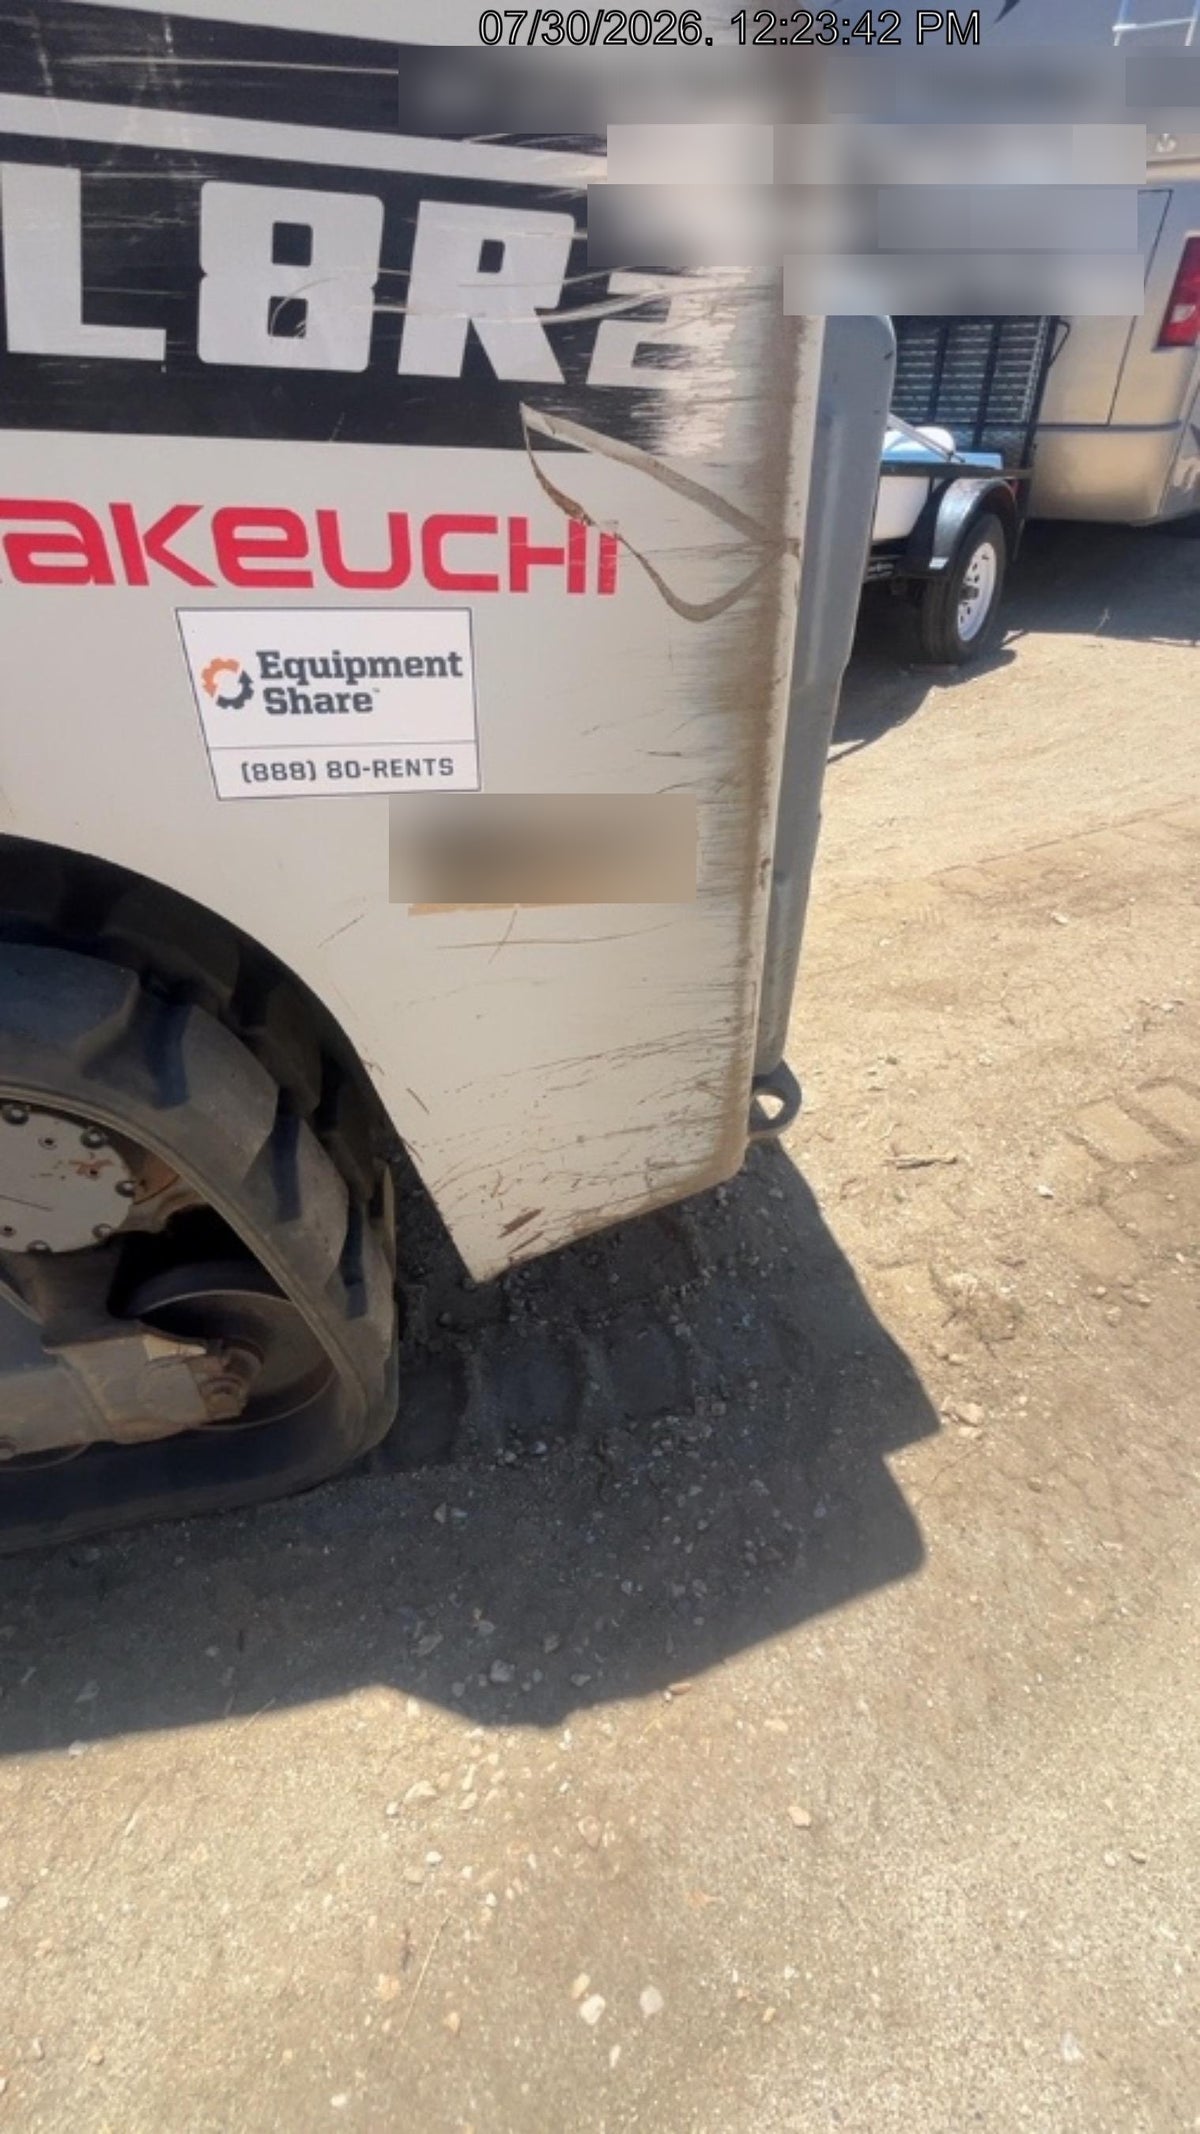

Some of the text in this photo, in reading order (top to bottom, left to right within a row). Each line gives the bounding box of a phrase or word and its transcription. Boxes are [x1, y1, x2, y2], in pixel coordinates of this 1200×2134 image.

[255, 650, 464, 686] Equipment
[240, 758, 454, 784] (888) 80-RENTS
